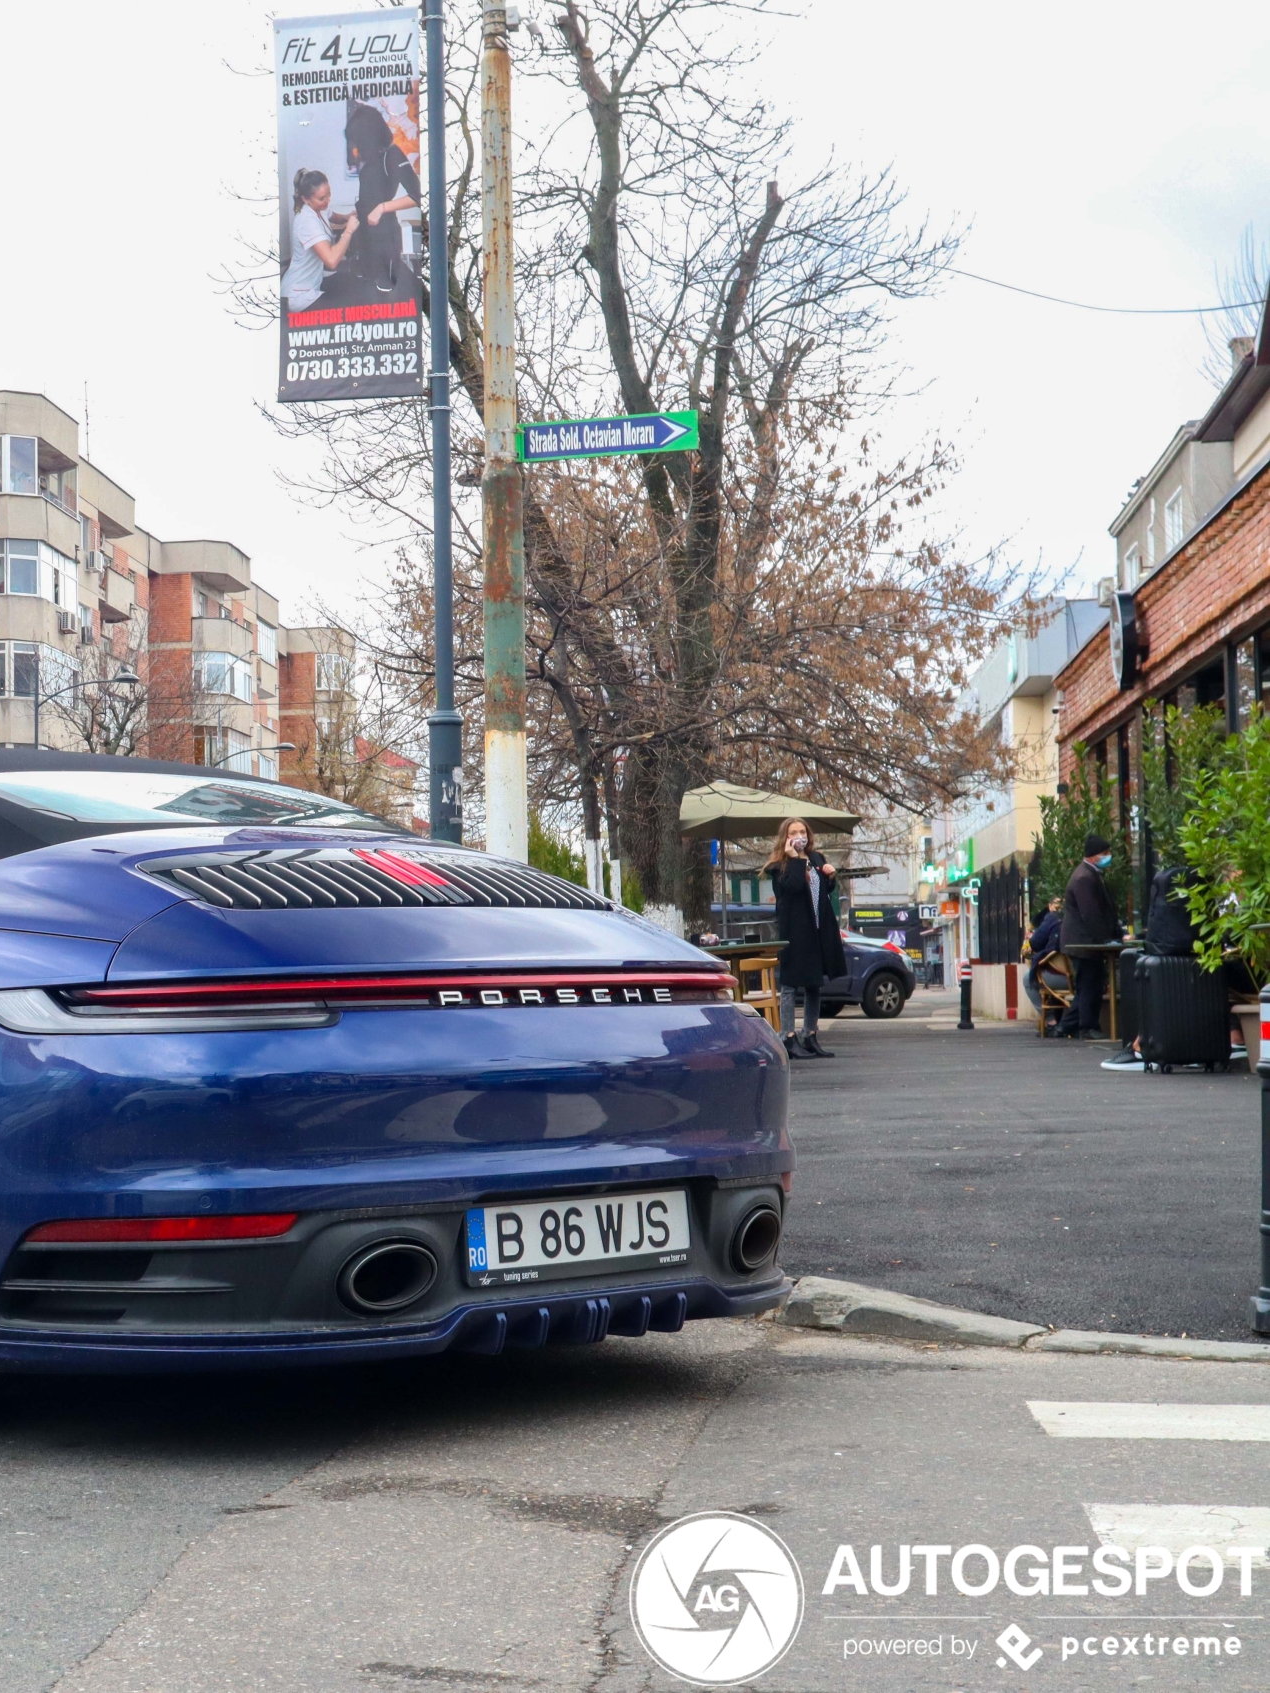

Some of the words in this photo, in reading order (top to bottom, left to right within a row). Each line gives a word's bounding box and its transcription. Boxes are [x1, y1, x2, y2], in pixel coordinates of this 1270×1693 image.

[320, 34, 342, 66] 4
[348, 33, 413, 63] you
[368, 53, 408, 64] CLINIQUE
[282, 68, 349, 87] REMODELARE
[351, 60, 413, 81] CORPORALĂ
[282, 93, 292, 106] &
[293, 82, 350, 106] ESTETICĂ
[351, 77, 413, 100] MEDICALĂ
[287, 308, 343, 328] TONIFIERE
[345, 298, 417, 321] MUSCULARĂ
[288, 320, 417, 347] www.fit4you.ro
[351, 344, 366, 354] Str.
[367, 341, 403, 352] Amman
[405, 340, 417, 350] 23
[286, 352, 418, 381] 0730.333.332
[529, 428, 558, 454] Strada
[559, 425, 582, 450] Sold.
[583, 423, 622, 449] Octavian
[623, 421, 655, 445] Moraru
[438, 988, 672, 1006] PORSCHE
[496, 1212, 525, 1264] B
[539, 1207, 586, 1259] 86
[594, 1200, 671, 1254] WJS
[469, 1247, 486, 1267] RO
[503, 1271, 521, 1282] tuning
[521, 1270, 539, 1280] series
